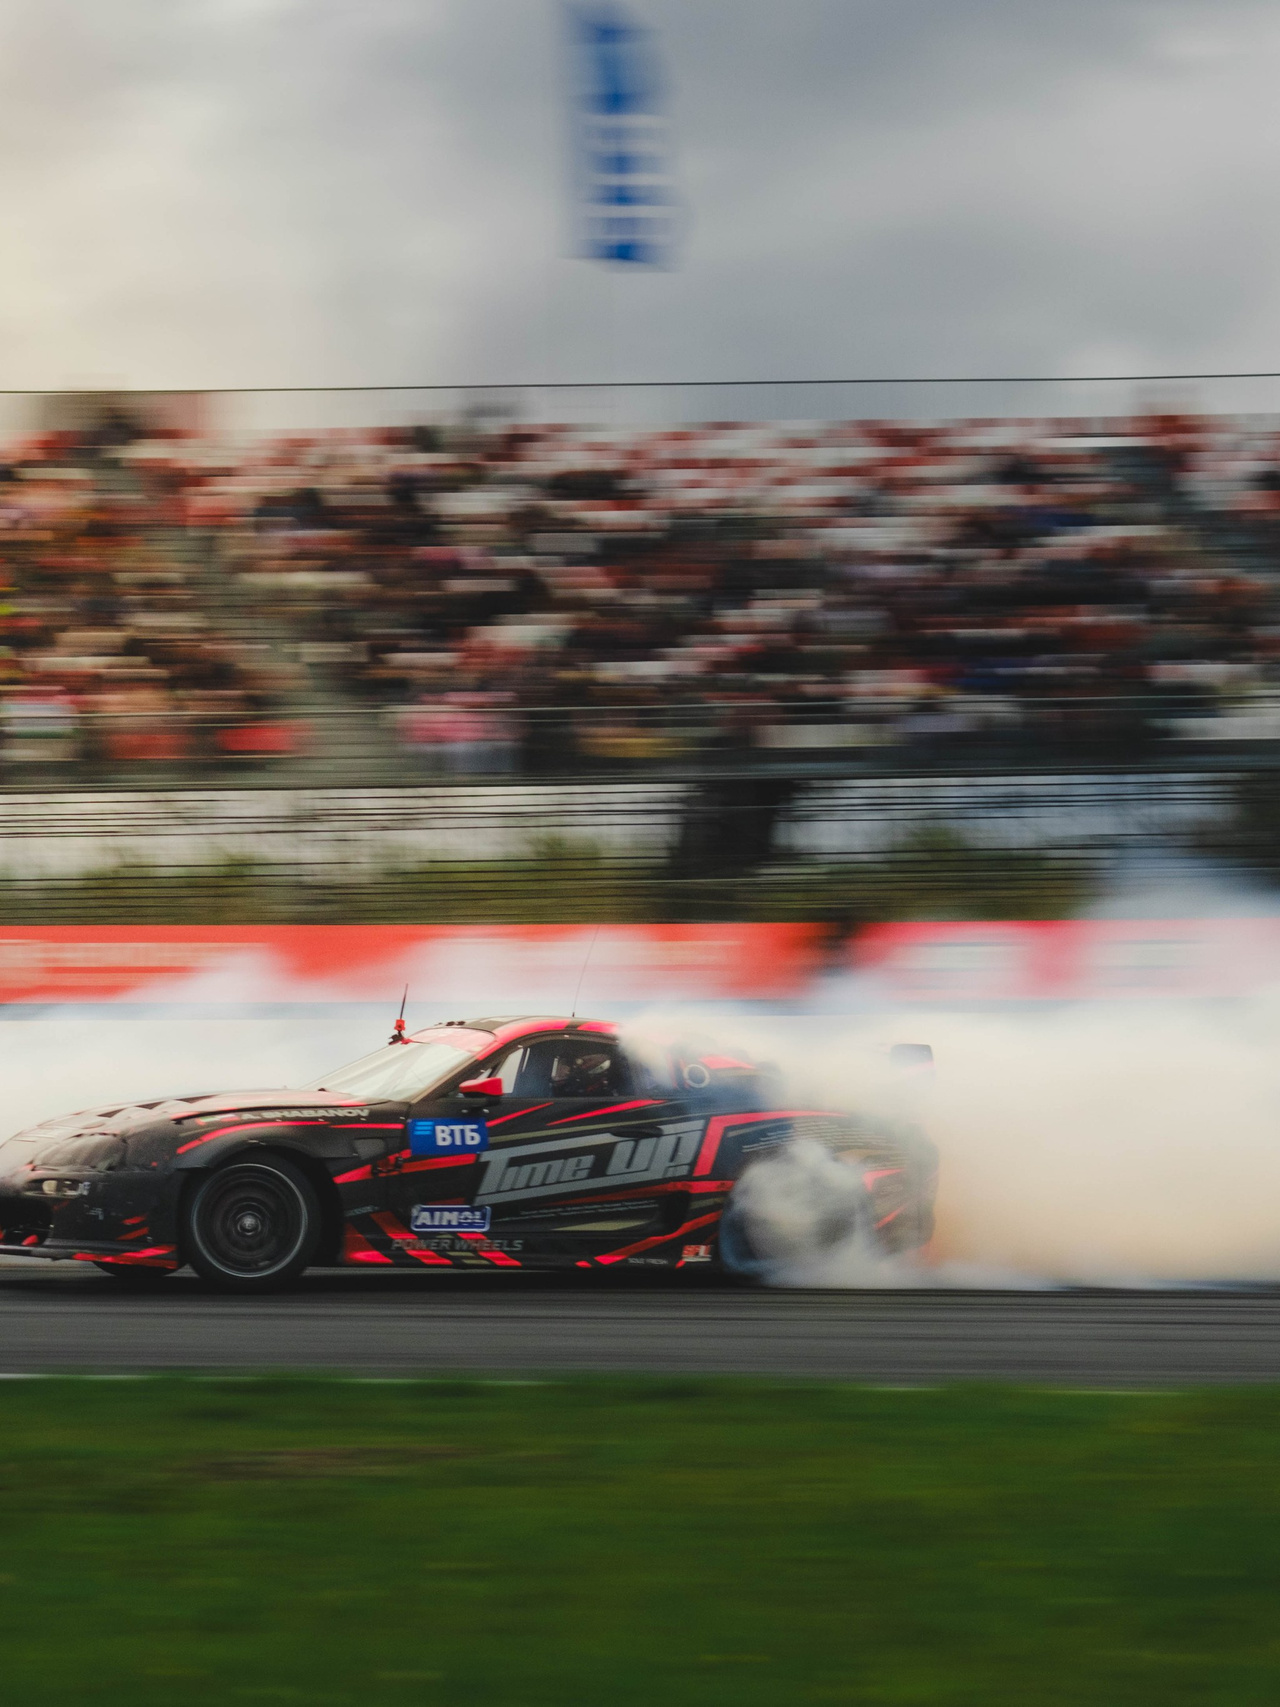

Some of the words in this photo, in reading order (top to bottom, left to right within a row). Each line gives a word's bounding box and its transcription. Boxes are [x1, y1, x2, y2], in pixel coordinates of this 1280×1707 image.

[261, 1108, 370, 1118] SHABANOV
[434, 1124, 481, 1146] ВТБ
[414, 1211, 486, 1226] AIMOL
[390, 1238, 450, 1251] POWER
[454, 1239, 524, 1251] WHEELS
